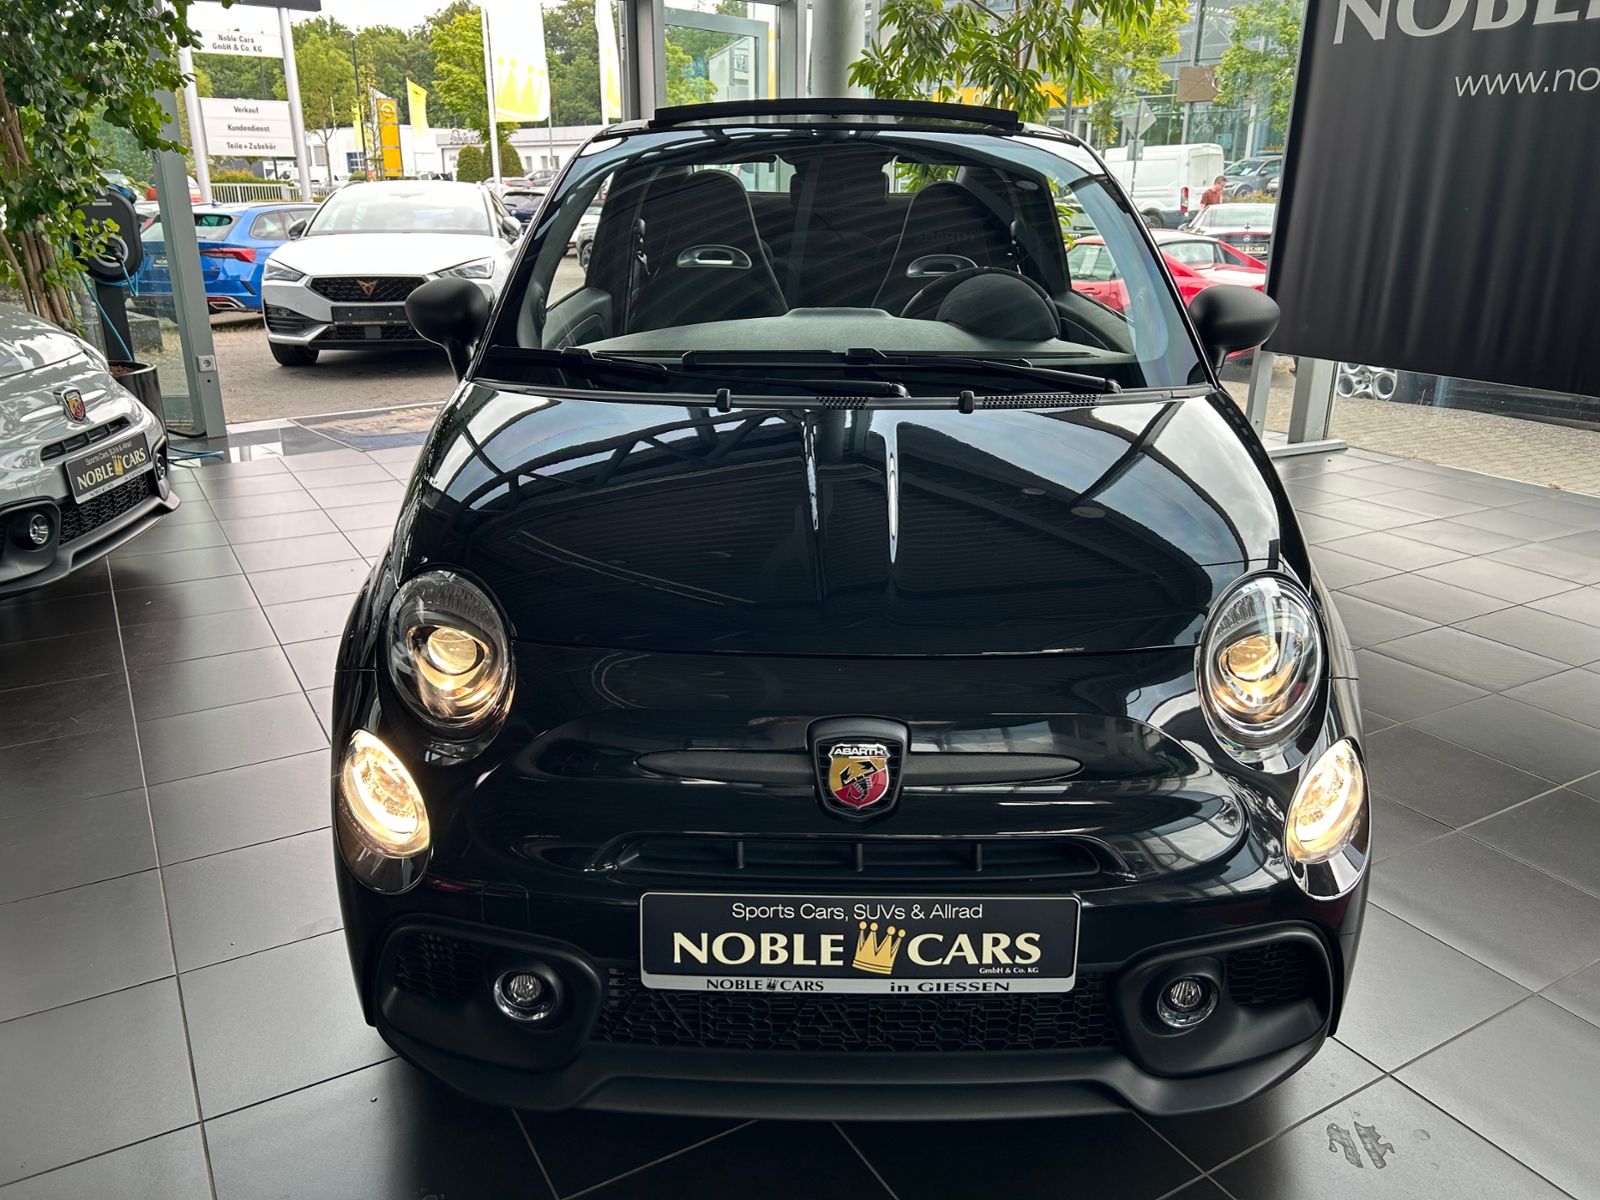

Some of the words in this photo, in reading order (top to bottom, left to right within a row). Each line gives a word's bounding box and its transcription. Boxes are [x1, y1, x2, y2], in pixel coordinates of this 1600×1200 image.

[218, 34, 237, 42] Noble
[212, 42, 232, 50] GmbH
[233, 106, 259, 114] Verkauf
[227, 124, 270, 133] Kundendienst
[77, 462, 115, 491] NOBLE
[122, 447, 146, 469] CARS
[834, 747, 884, 756] ABARTH
[731, 902, 796, 921] Sports
[799, 903, 849, 921] Cars,
[853, 903, 906, 920] SUVs
[910, 904, 926, 920] &
[929, 904, 983, 919] Allrad
[673, 932, 845, 966] NOBLE
[906, 932, 1042, 967] CARS
[706, 979, 763, 991] NOBLE
[779, 980, 825, 992] CARS
[890, 981, 909, 993] in
[917, 982, 1010, 993] GIESSEN
